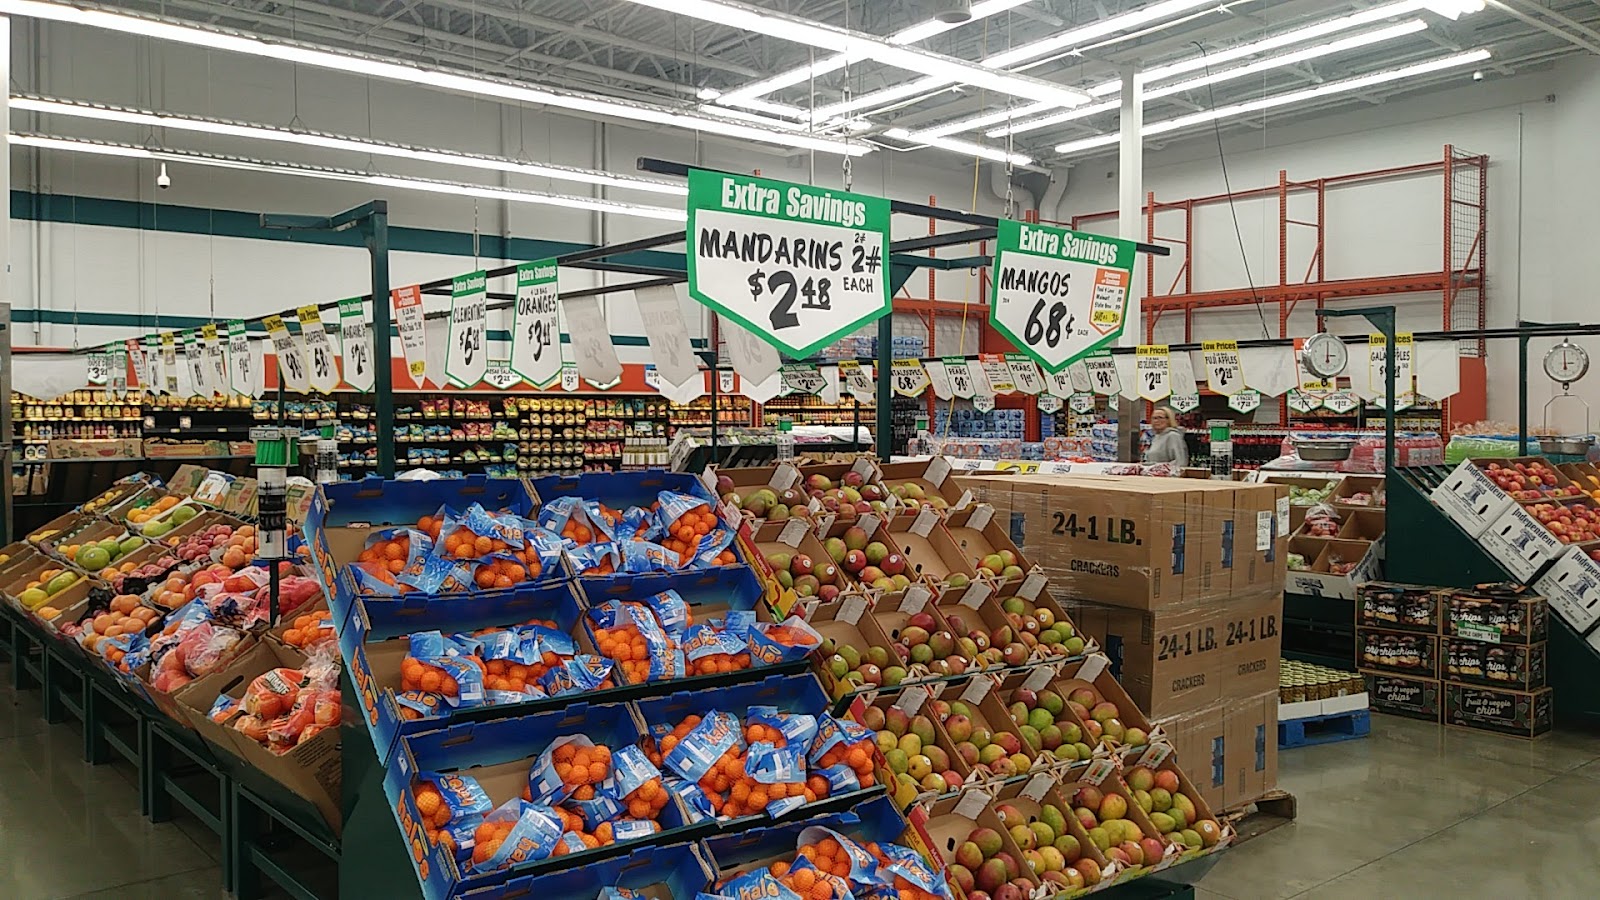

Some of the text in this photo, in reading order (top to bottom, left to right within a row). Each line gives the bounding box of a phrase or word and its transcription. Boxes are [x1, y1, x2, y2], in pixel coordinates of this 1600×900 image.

[721, 177, 866, 227] Extra Savings
[700, 228, 881, 274] MANDARINS 2#
[1018, 225, 1118, 265] Extra Savings
[519, 265, 556, 282] Extra Savings
[1000, 267, 1071, 297] MANGOS
[454, 277, 485, 292] Extra Savings
[843, 277, 874, 293] EACH
[518, 294, 556, 316] ORANGES
[1216, 342, 1236, 350] Prices
[1370, 336, 1386, 344] Low
[1218, 356, 1238, 364] APPLES
[1371, 351, 1410, 362] GALA PPLES
[1010, 364, 1032, 372] PEARS
[1464, 462, 1506, 502] Independent
[1052, 512, 1142, 546] 24-1 LB.
[1512, 508, 1556, 548] Independent
[1070, 559, 1120, 578] CRACKERS
[1226, 615, 1278, 646] 24-1 LB.
[748, 634, 784, 664] halos
[1158, 627, 1218, 661] 24-1 LB.
[1238, 659, 1266, 676] CRACKERS
[1172, 674, 1206, 692] CRACKERS
[1388, 693, 1411, 702] chips
[1488, 700, 1512, 708] veggie
[1476, 706, 1502, 716] chips
